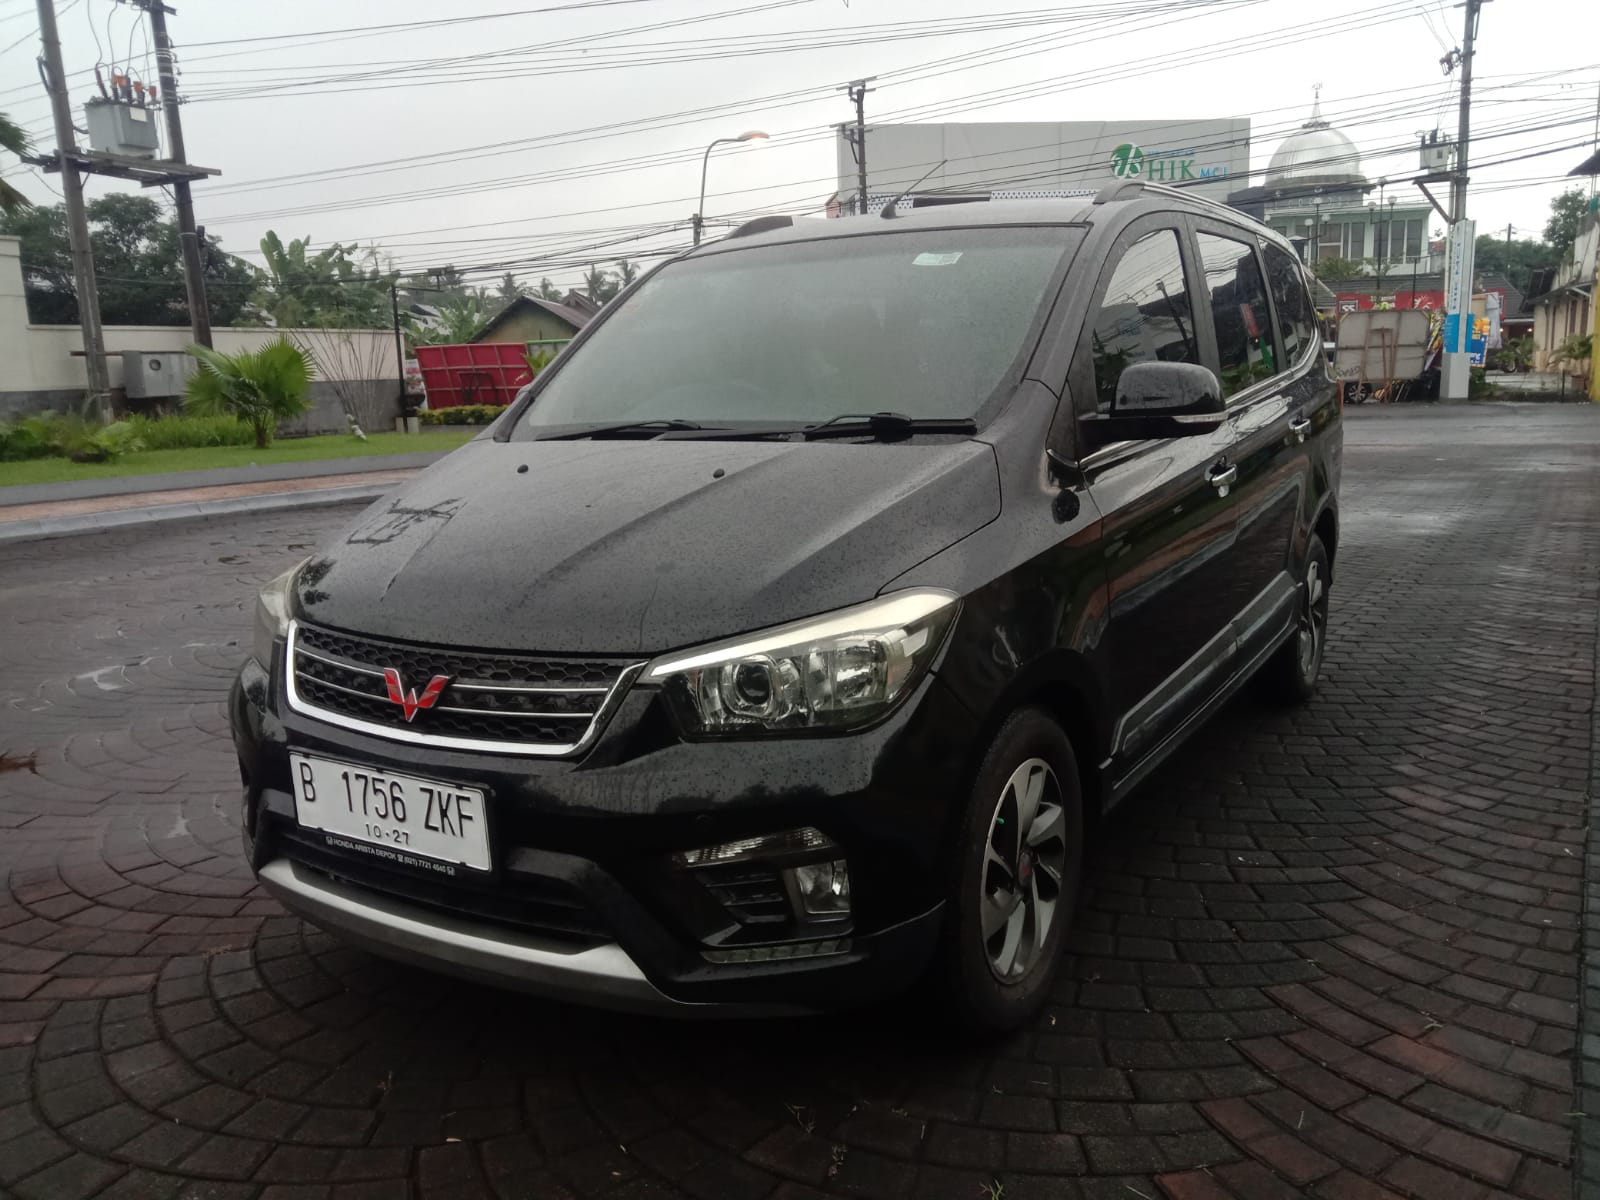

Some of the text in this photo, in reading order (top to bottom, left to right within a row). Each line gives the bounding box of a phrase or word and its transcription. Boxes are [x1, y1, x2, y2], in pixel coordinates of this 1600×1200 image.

[1147, 159, 1196, 181] HIK
[299, 762, 474, 838] B 1756 ZKF
[333, 838, 354, 849] HONDA
[375, 849, 397, 860] DEPOK
